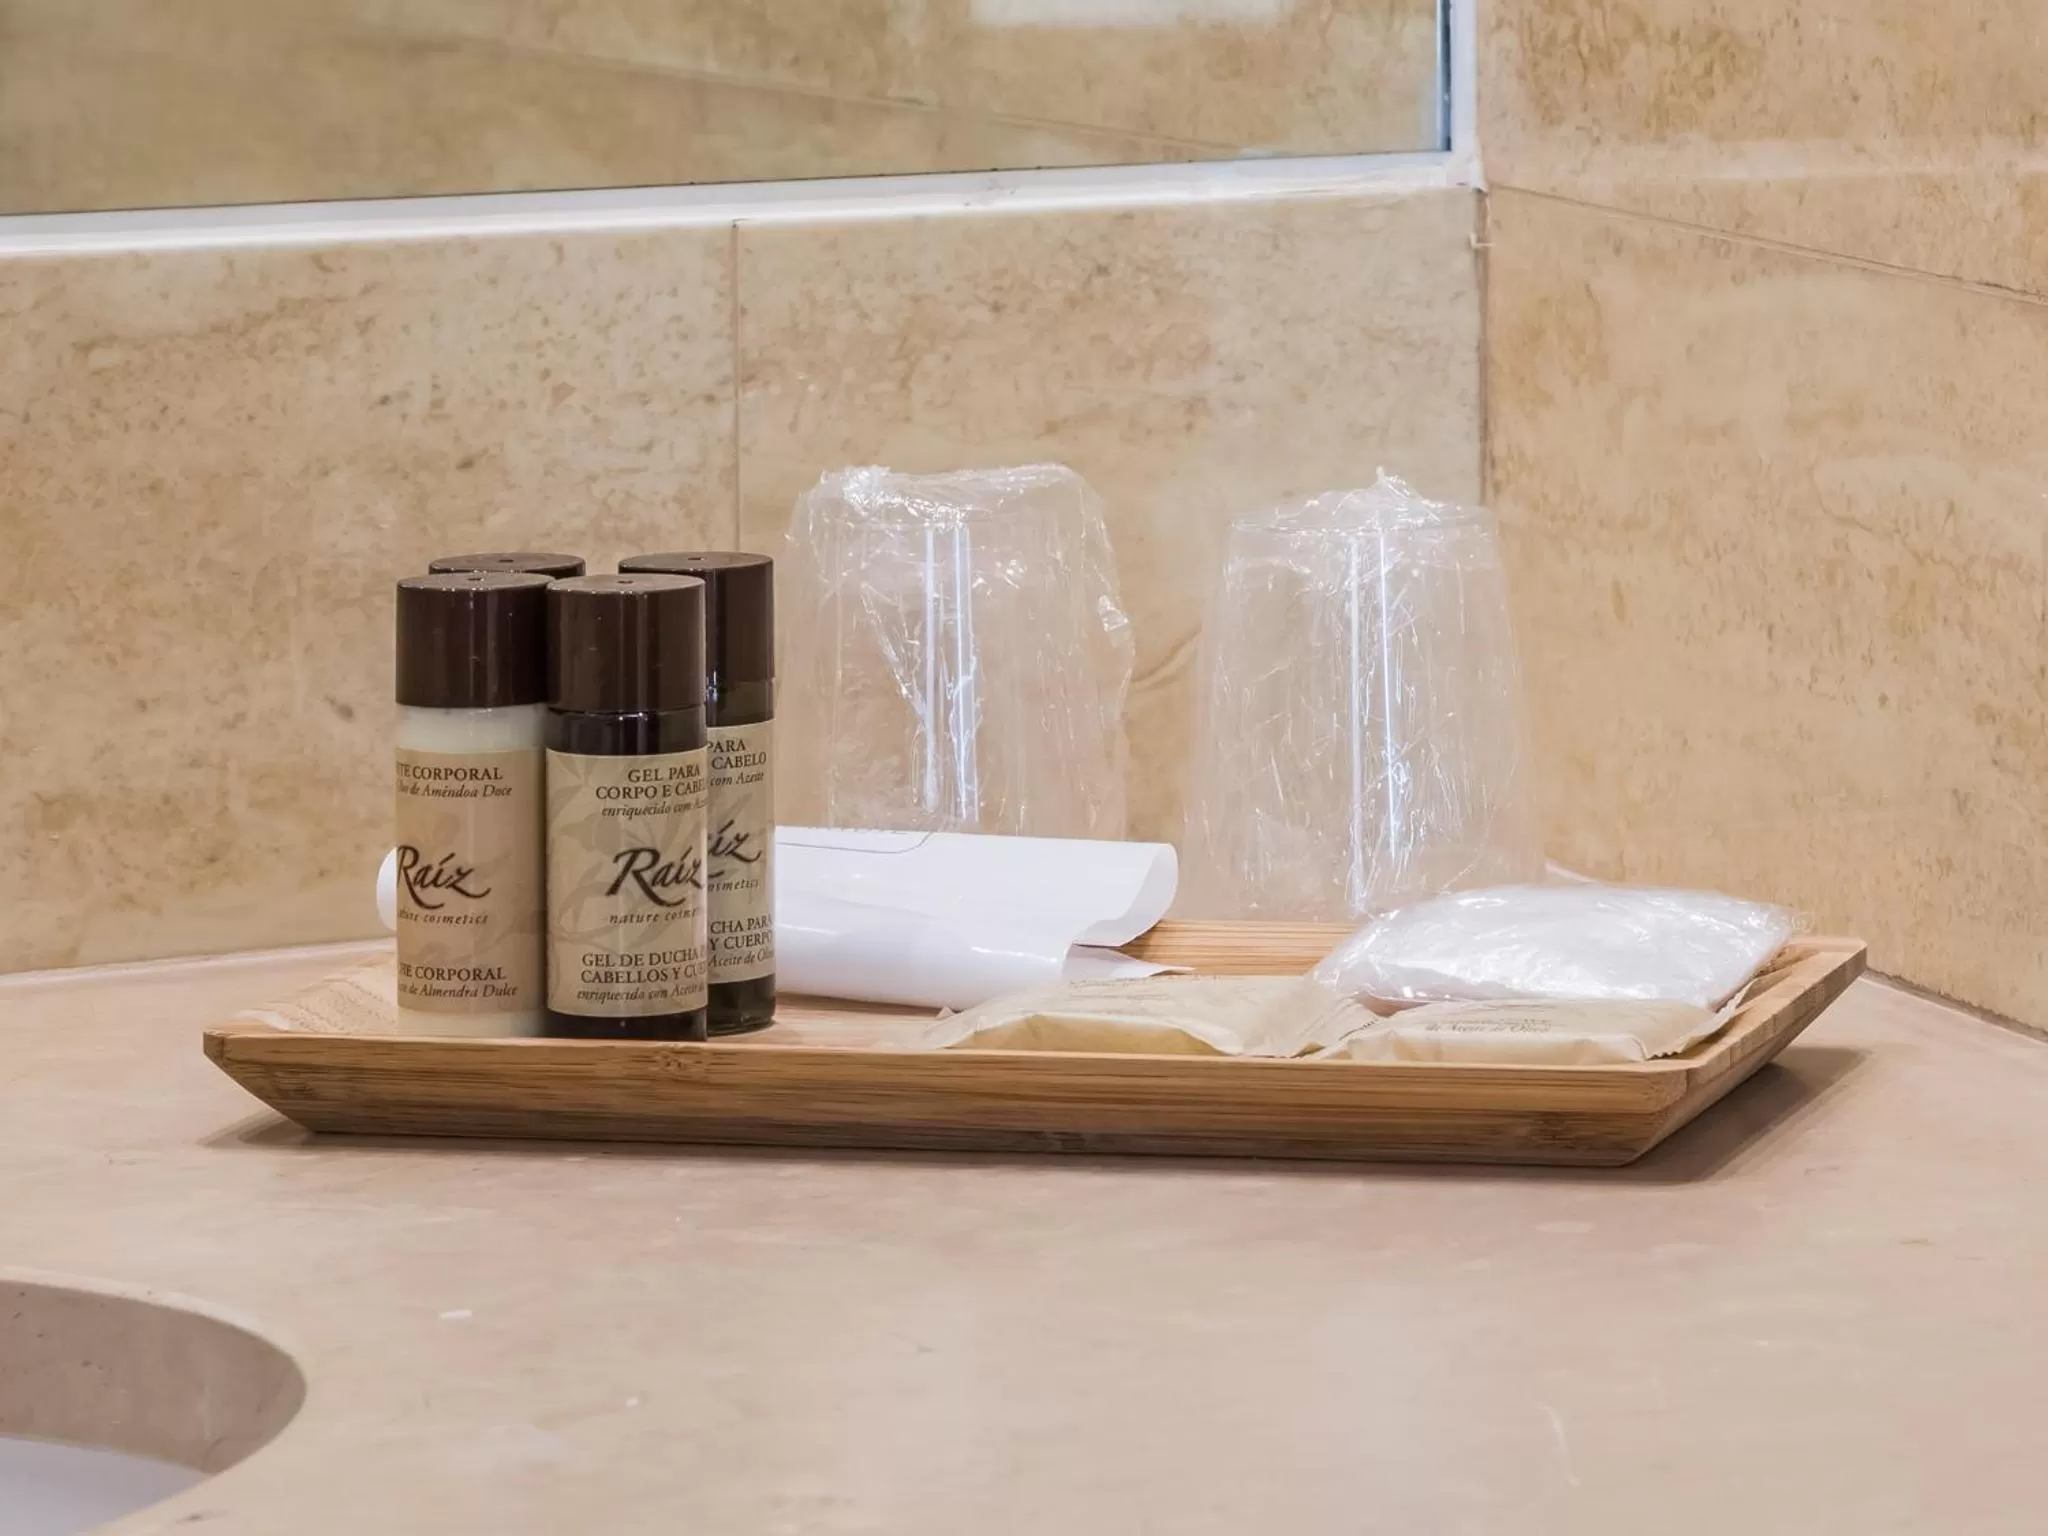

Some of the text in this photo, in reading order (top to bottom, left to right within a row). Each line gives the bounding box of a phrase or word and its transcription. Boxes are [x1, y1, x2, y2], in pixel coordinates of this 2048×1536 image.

[711, 751, 767, 770] CABELO
[412, 765, 504, 781] CORPORAL
[627, 764, 700, 783] GEL PARA
[483, 784, 513, 797] Doce
[595, 785, 658, 801] CORPO
[662, 784, 672, 798] E
[601, 801, 671, 820] enriquecido
[396, 845, 492, 910] Raíz
[604, 845, 704, 907] Raíz
[609, 914, 660, 924] nature
[709, 938, 720, 951] Y
[582, 953, 616, 968] GEL
[620, 953, 645, 967] DE
[649, 948, 699, 966] DUCHA
[414, 966, 508, 981] CORPORAL
[581, 967, 668, 984] CABELLOS
[672, 966, 681, 980] Y
[419, 983, 479, 998] Almendra
[482, 982, 519, 997] Dulce
[577, 986, 644, 1005] enriquecido
